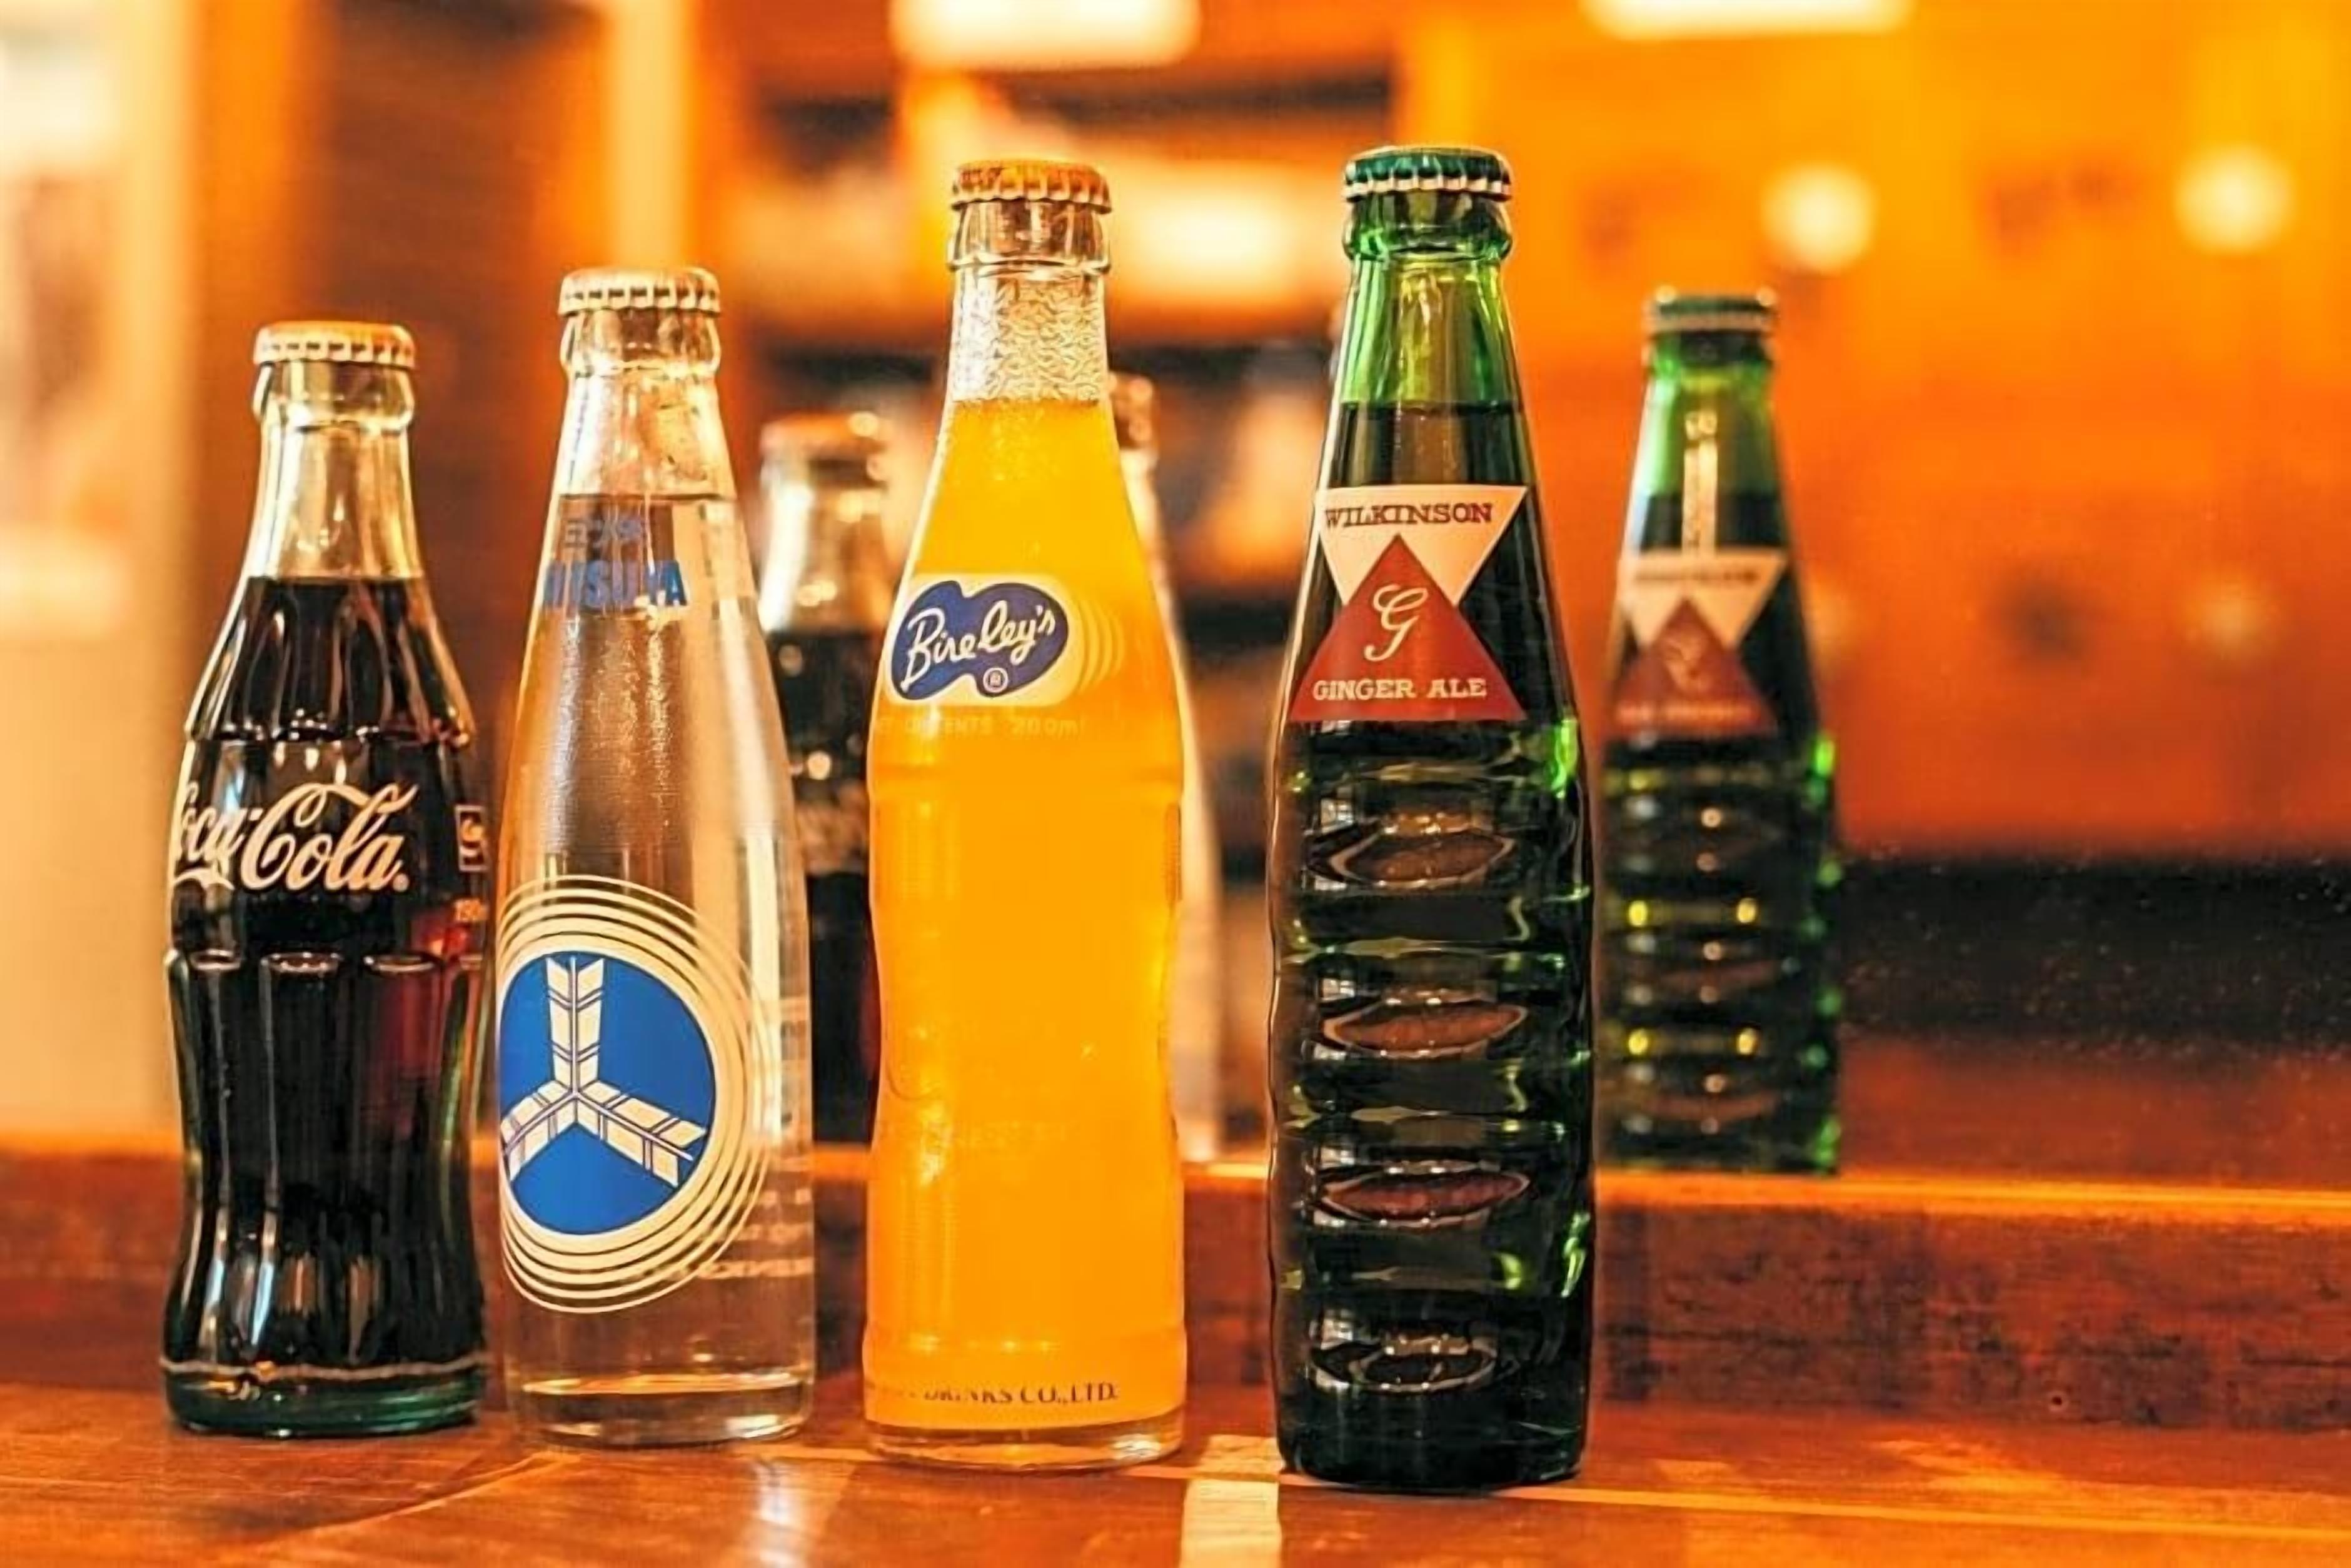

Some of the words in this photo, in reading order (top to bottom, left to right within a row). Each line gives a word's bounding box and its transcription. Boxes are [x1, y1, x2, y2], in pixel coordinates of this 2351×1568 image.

[1324, 503, 1493, 528] WILKINSON
[900, 600, 1057, 693] Bireley's
[1312, 679, 1416, 701] GINGER
[1426, 677, 1488, 700] ALE
